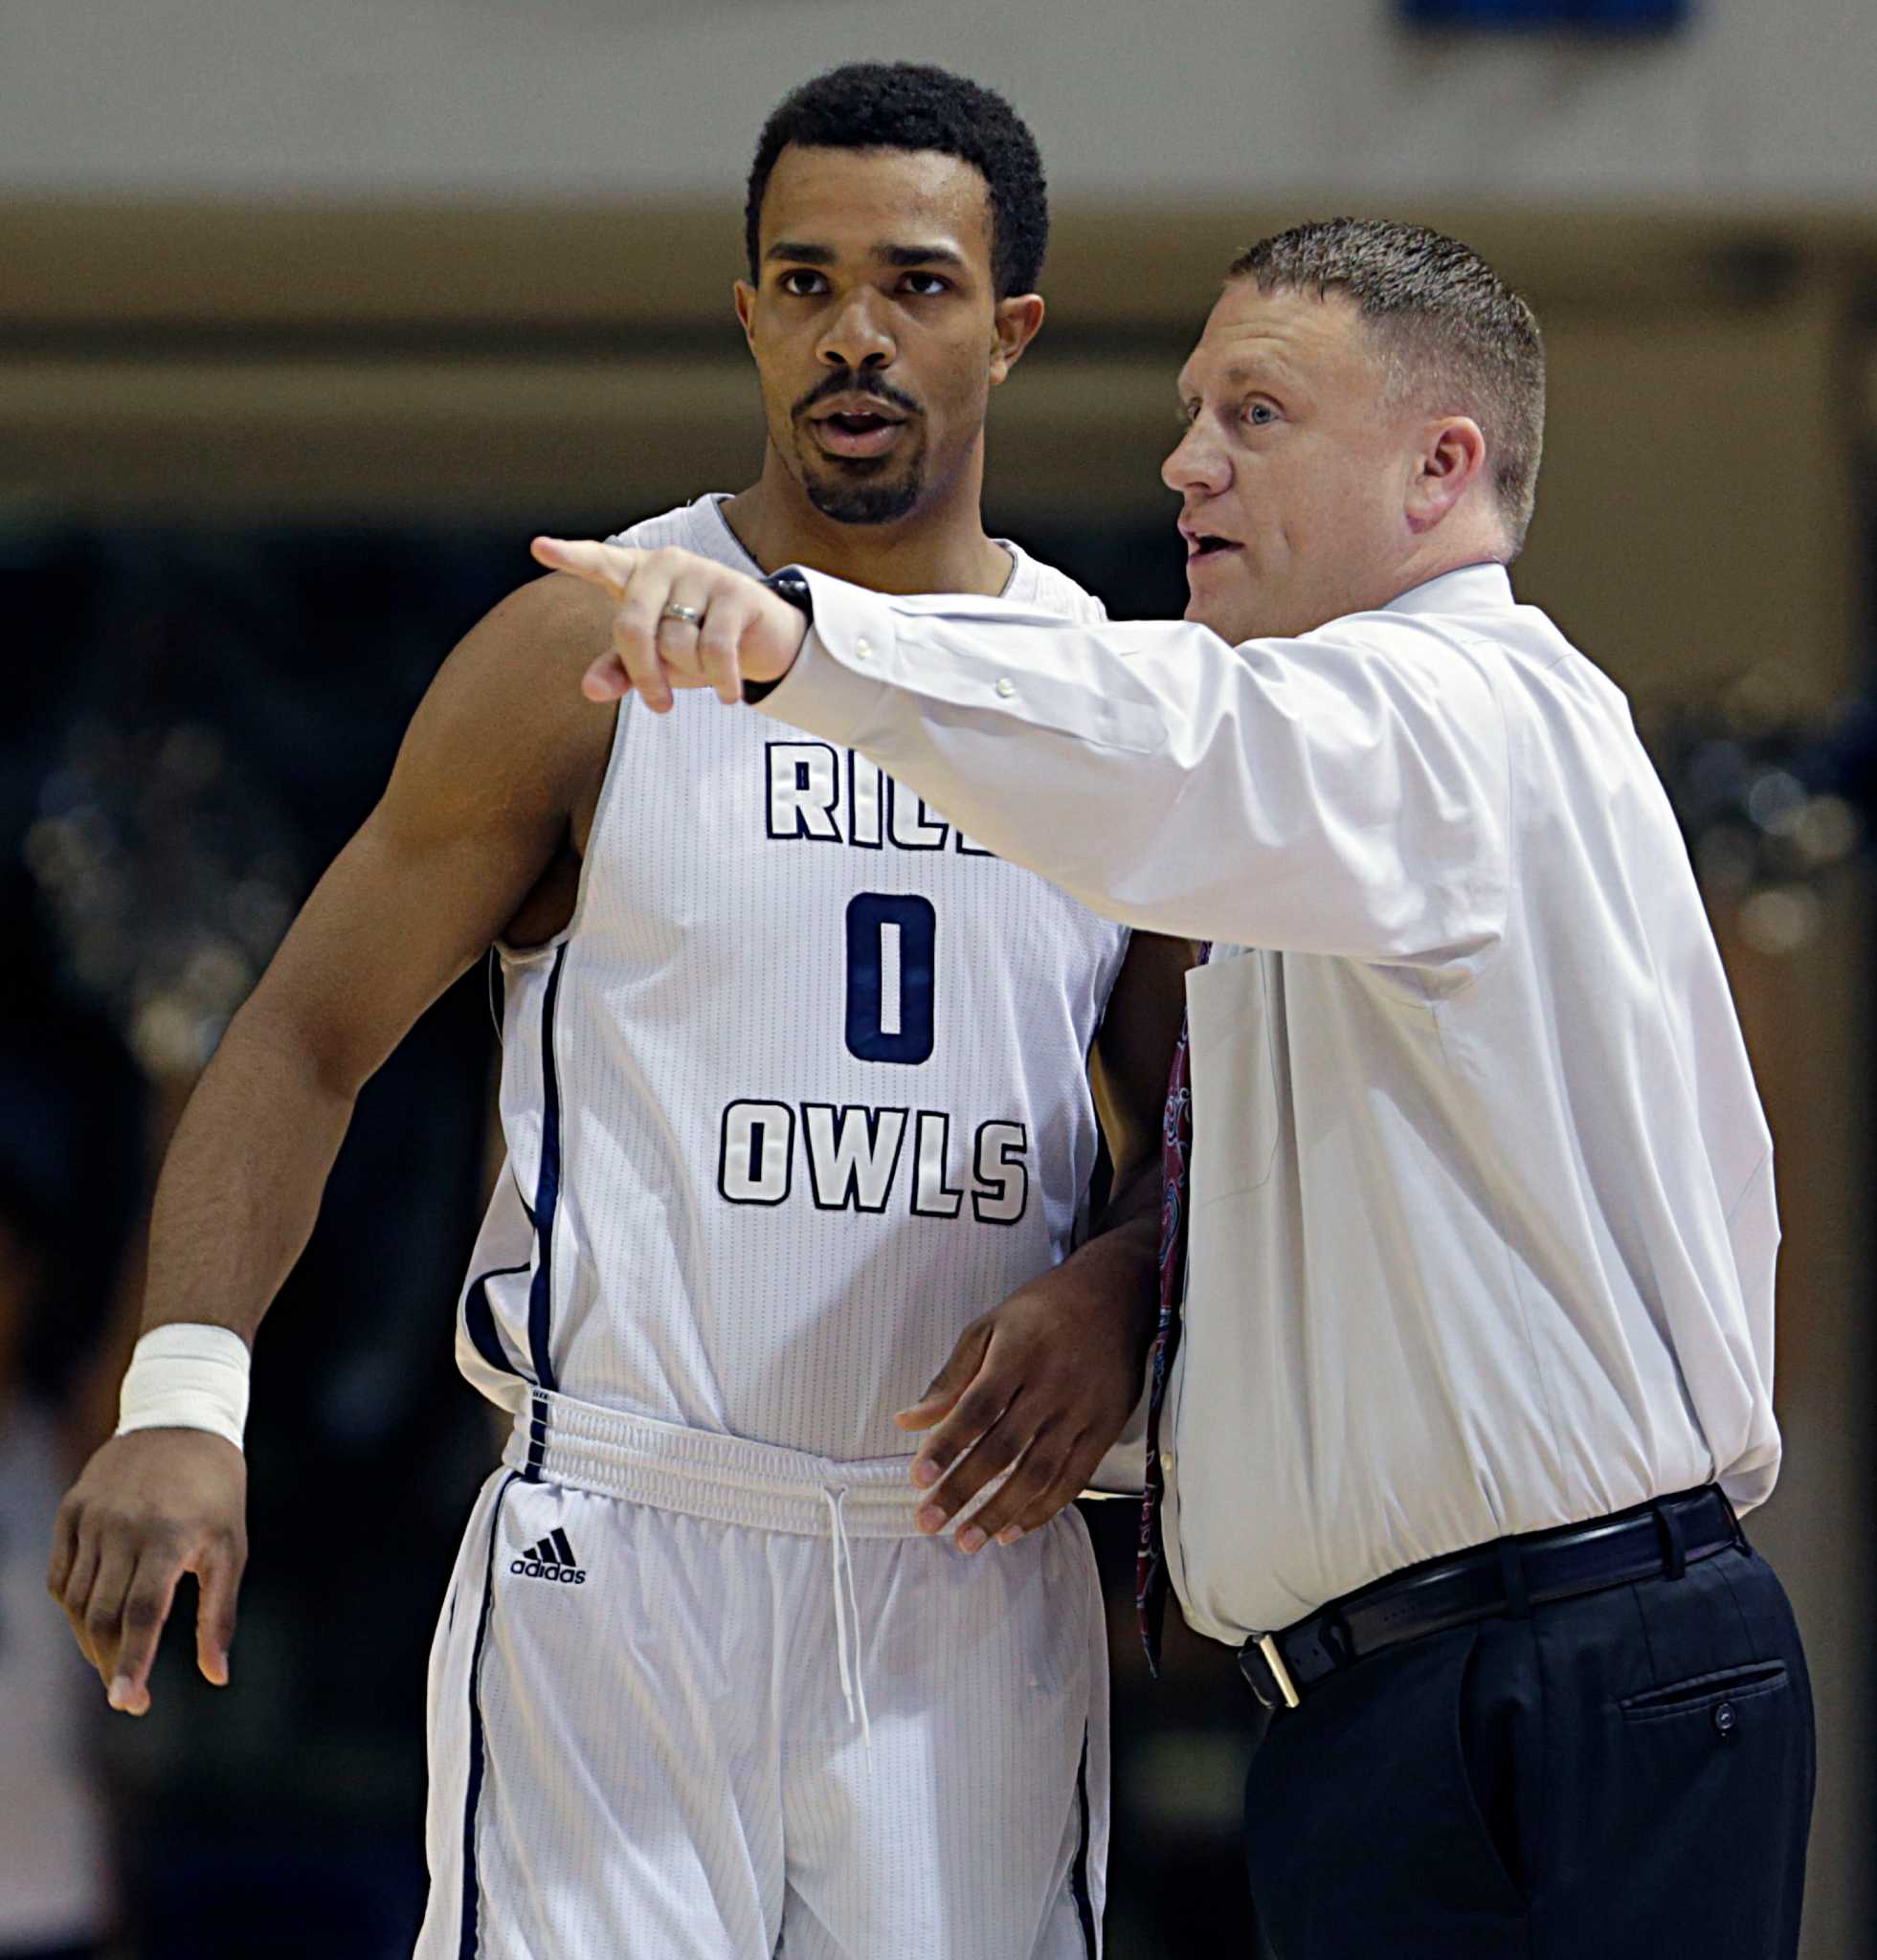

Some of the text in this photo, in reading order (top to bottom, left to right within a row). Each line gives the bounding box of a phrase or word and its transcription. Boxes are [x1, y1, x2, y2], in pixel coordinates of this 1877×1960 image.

[766, 742, 998, 857] RIC
[845, 892, 935, 1064] 0
[718, 1099, 1028, 1225] OWLS
[510, 1558, 587, 1585] adidas
